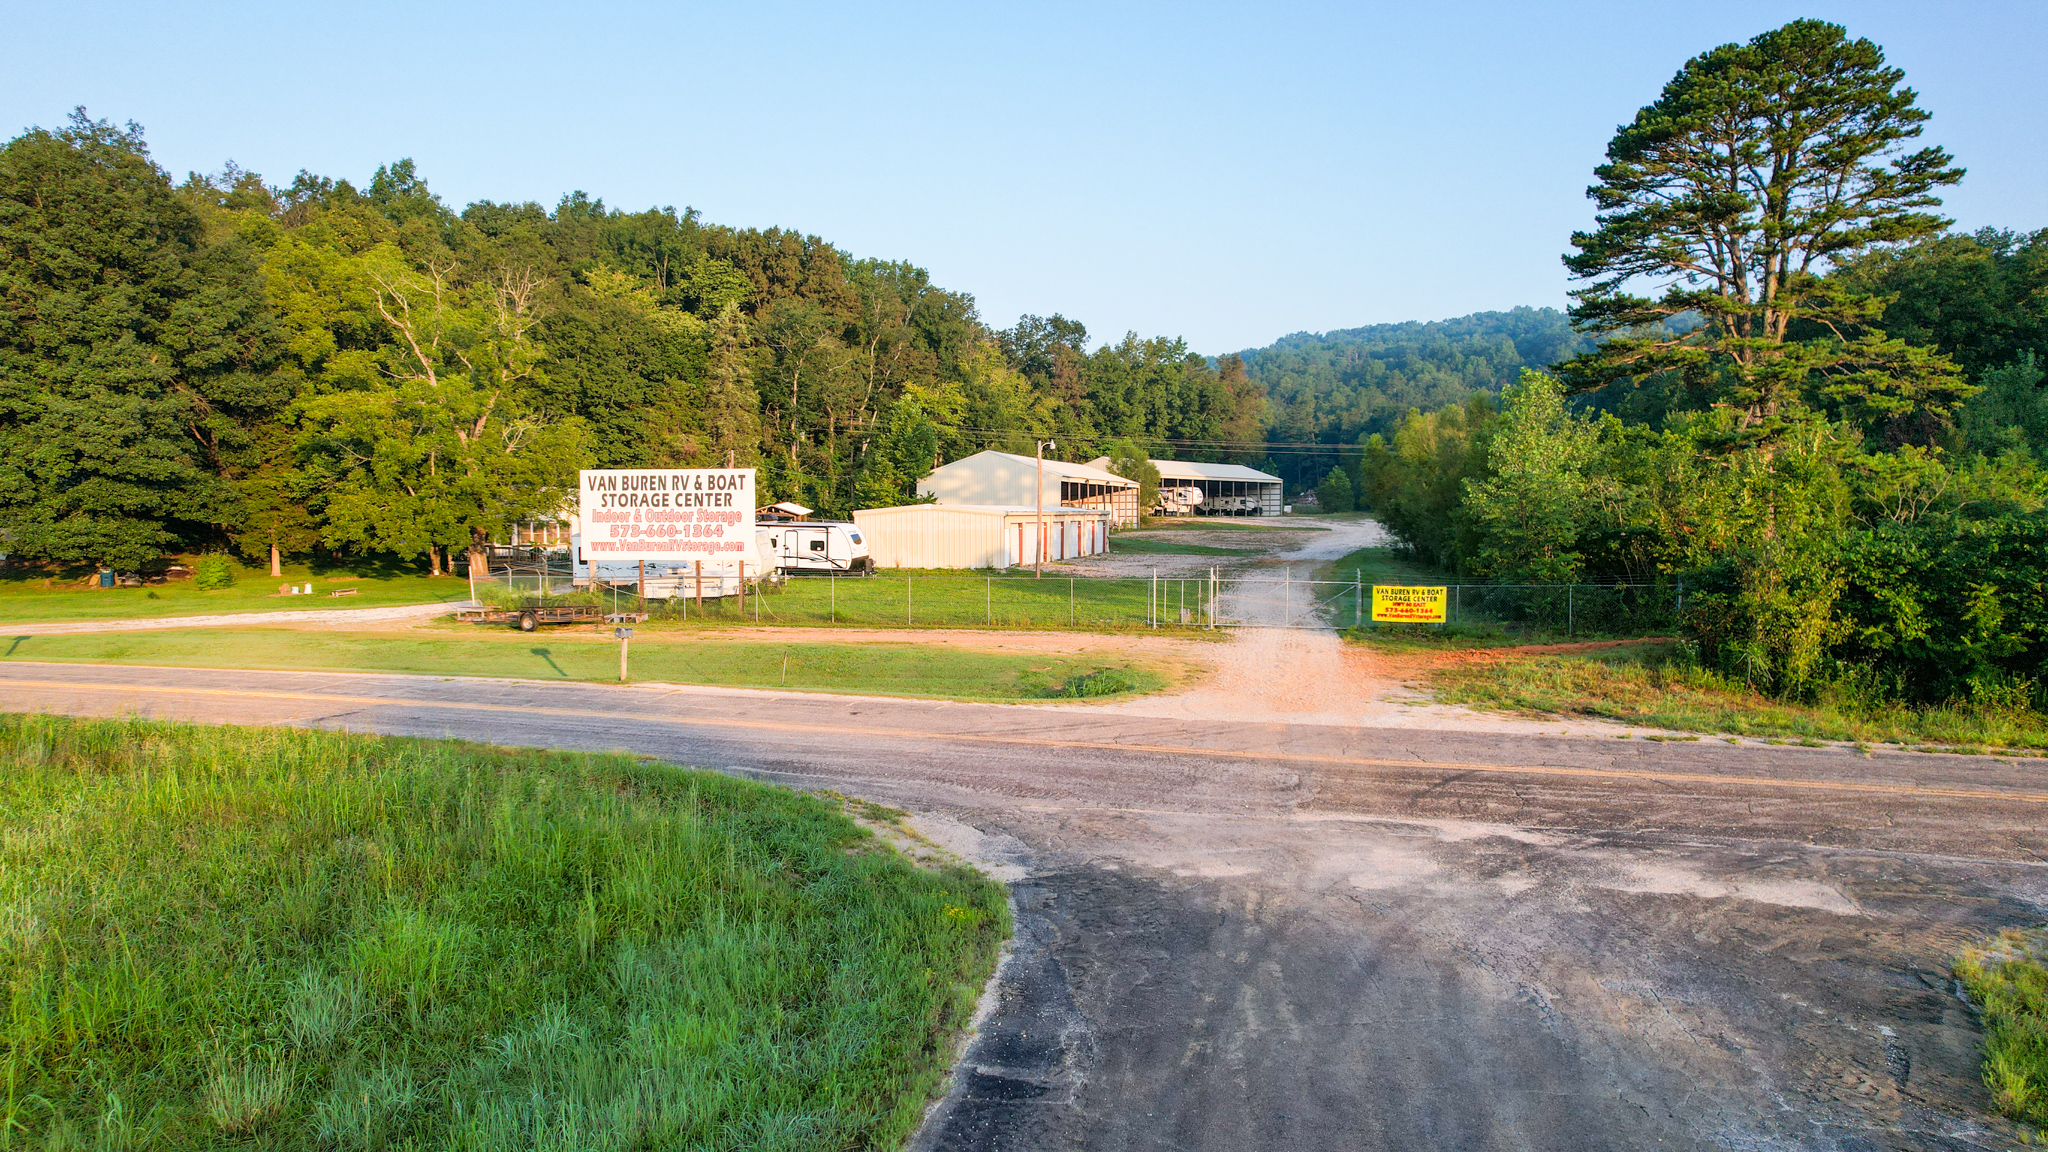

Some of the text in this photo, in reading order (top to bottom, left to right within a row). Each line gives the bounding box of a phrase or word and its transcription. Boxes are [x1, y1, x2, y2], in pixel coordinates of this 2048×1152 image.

[588, 474, 746, 491] VAN BUREN RV & BOAT
[601, 492, 733, 507] STORAGE CENTER
[592, 508, 743, 527] Indoor & Outdoor Storage
[610, 524, 724, 538] 573-660-1364
[590, 538, 745, 555] www.VanBurenRVstorage.com
